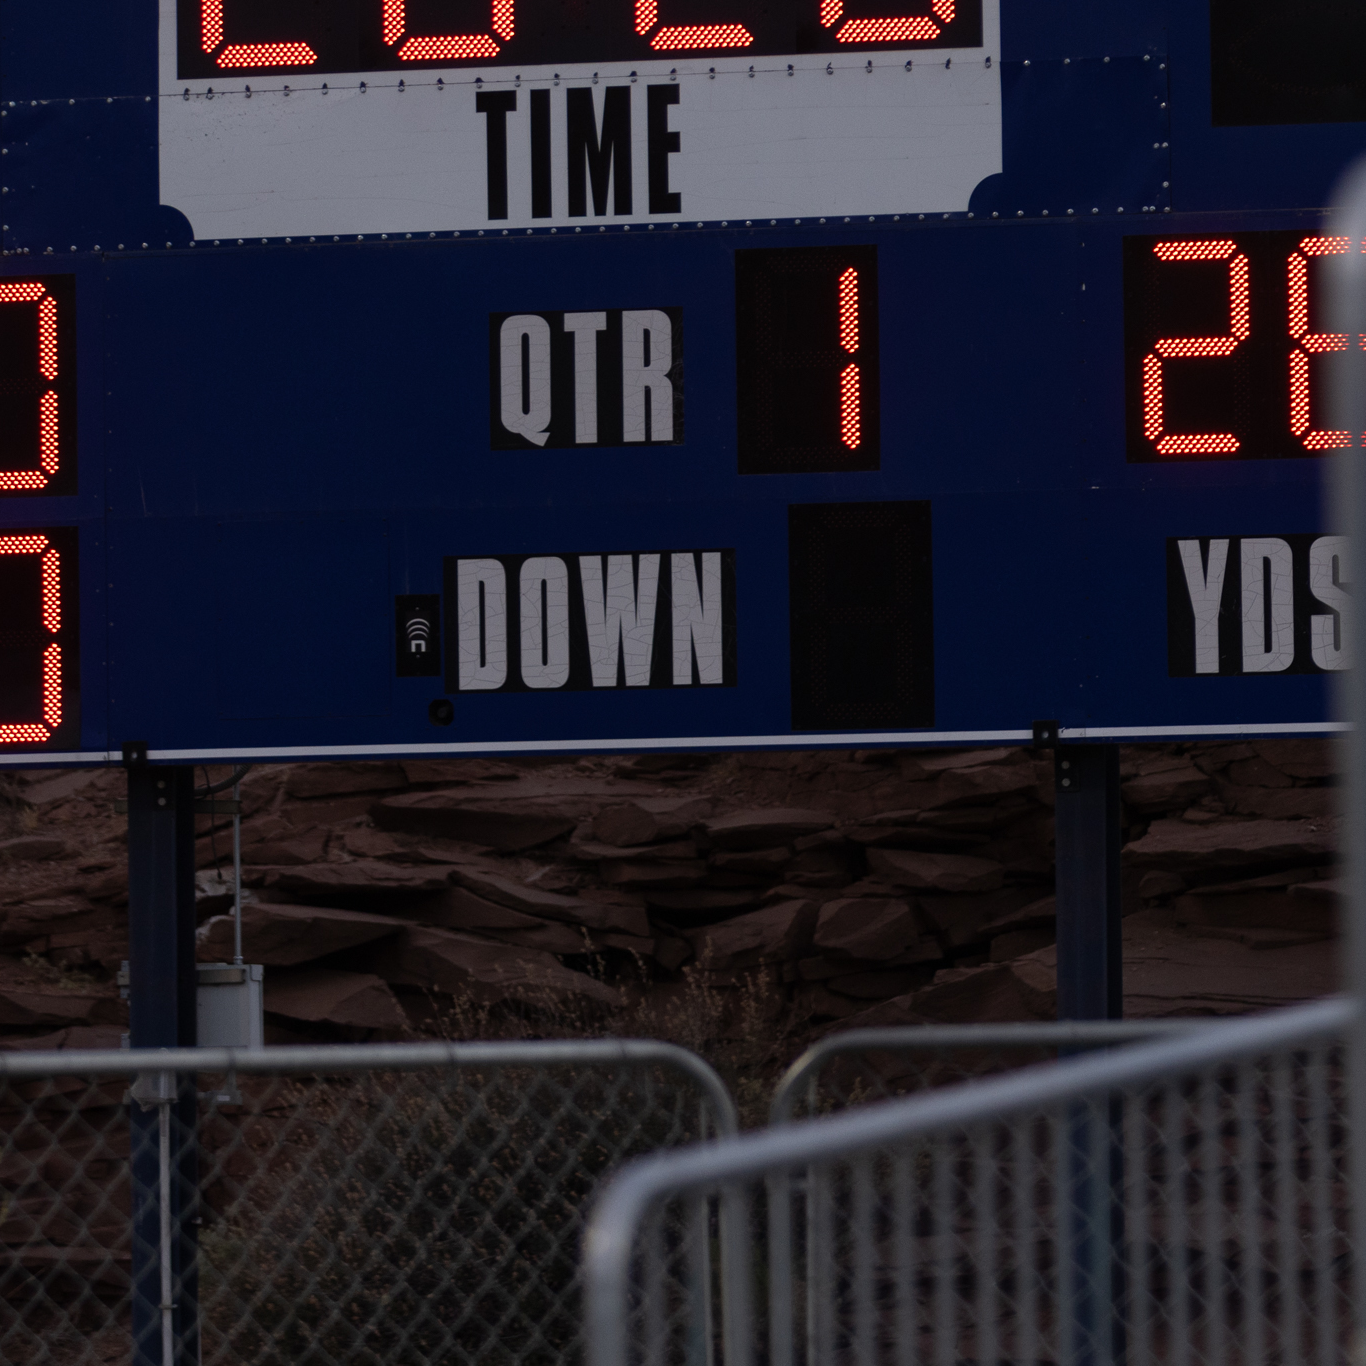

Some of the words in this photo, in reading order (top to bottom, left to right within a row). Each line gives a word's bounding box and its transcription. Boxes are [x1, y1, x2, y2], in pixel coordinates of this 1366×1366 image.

[475, 83, 683, 221] TIME
[499, 308, 675, 447] QTR
[838, 267, 861, 450] 1
[457, 551, 723, 691] DOWN
[1177, 536, 1357, 674] YDS
